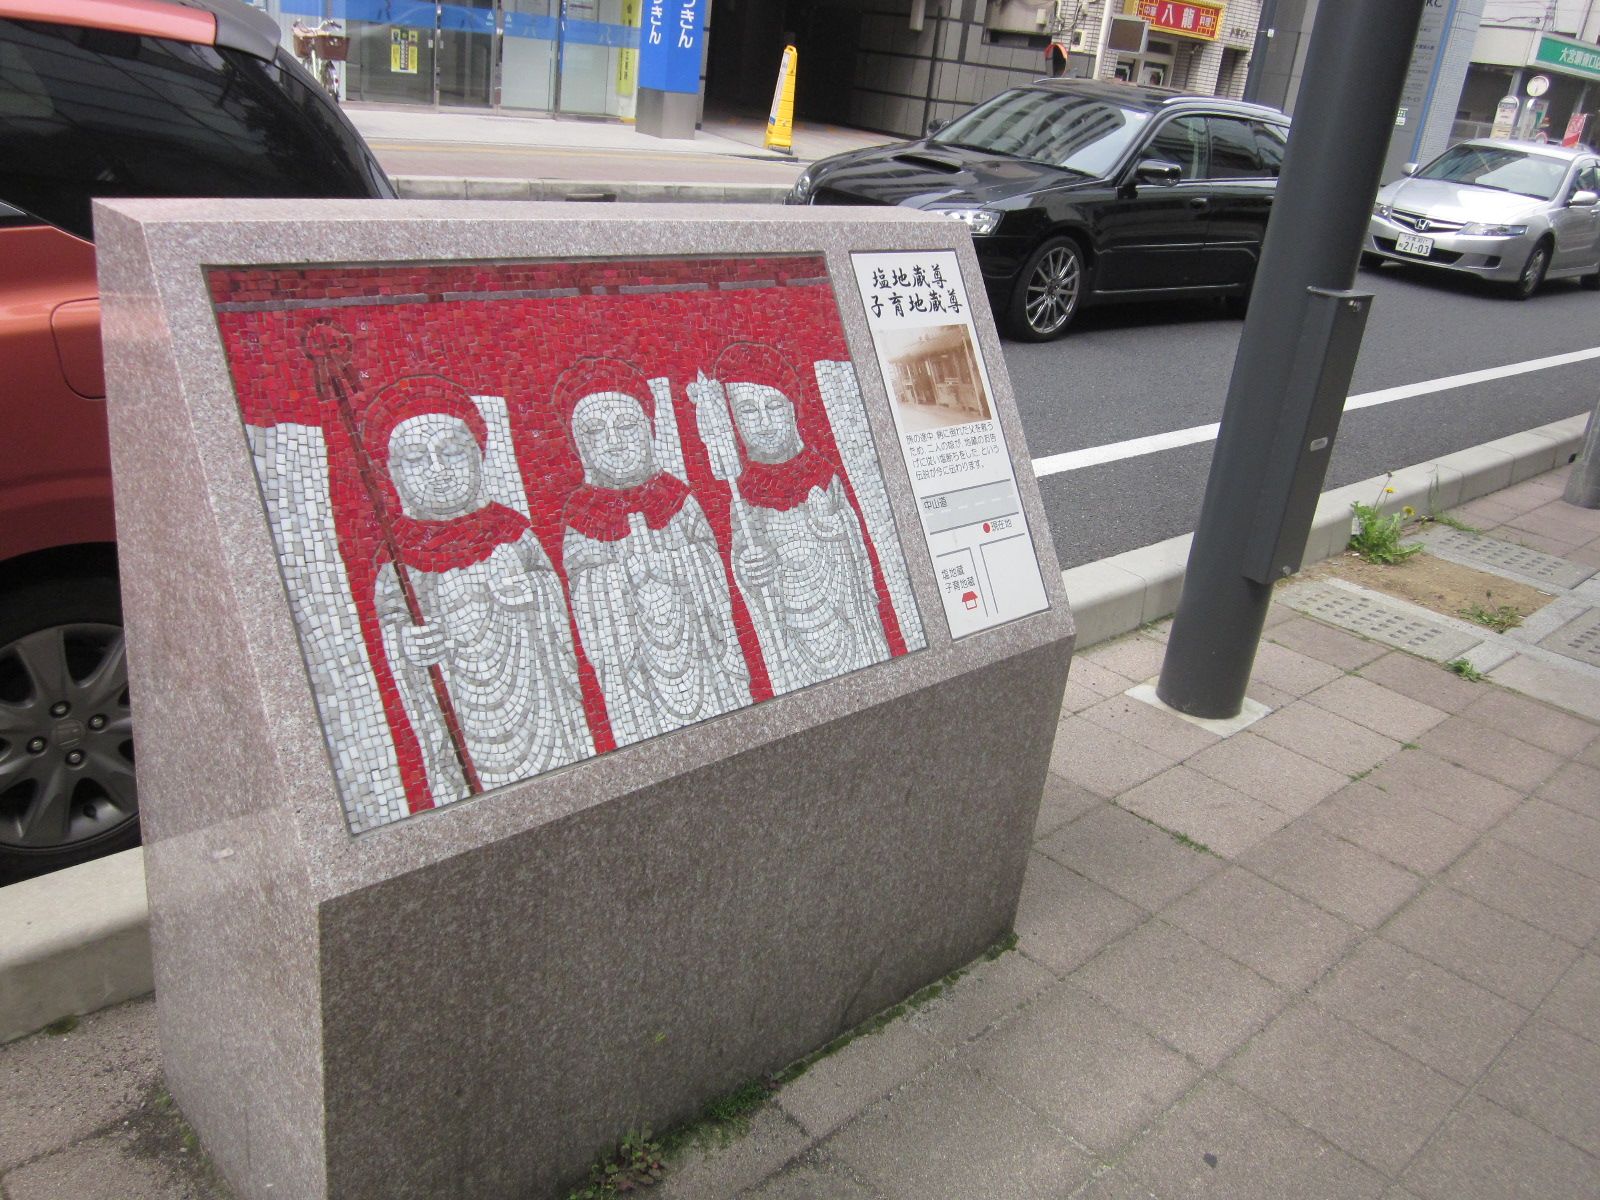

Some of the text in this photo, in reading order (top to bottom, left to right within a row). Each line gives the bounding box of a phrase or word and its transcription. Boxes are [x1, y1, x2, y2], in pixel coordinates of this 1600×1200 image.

[1161, 4, 1196, 29] 八龍
[873, 264, 947, 289] 塩地蔵尊
[871, 289, 963, 318] 子育地蔵尊
[923, 497, 948, 509] 中山道
[991, 519, 1013, 531] 現在地
